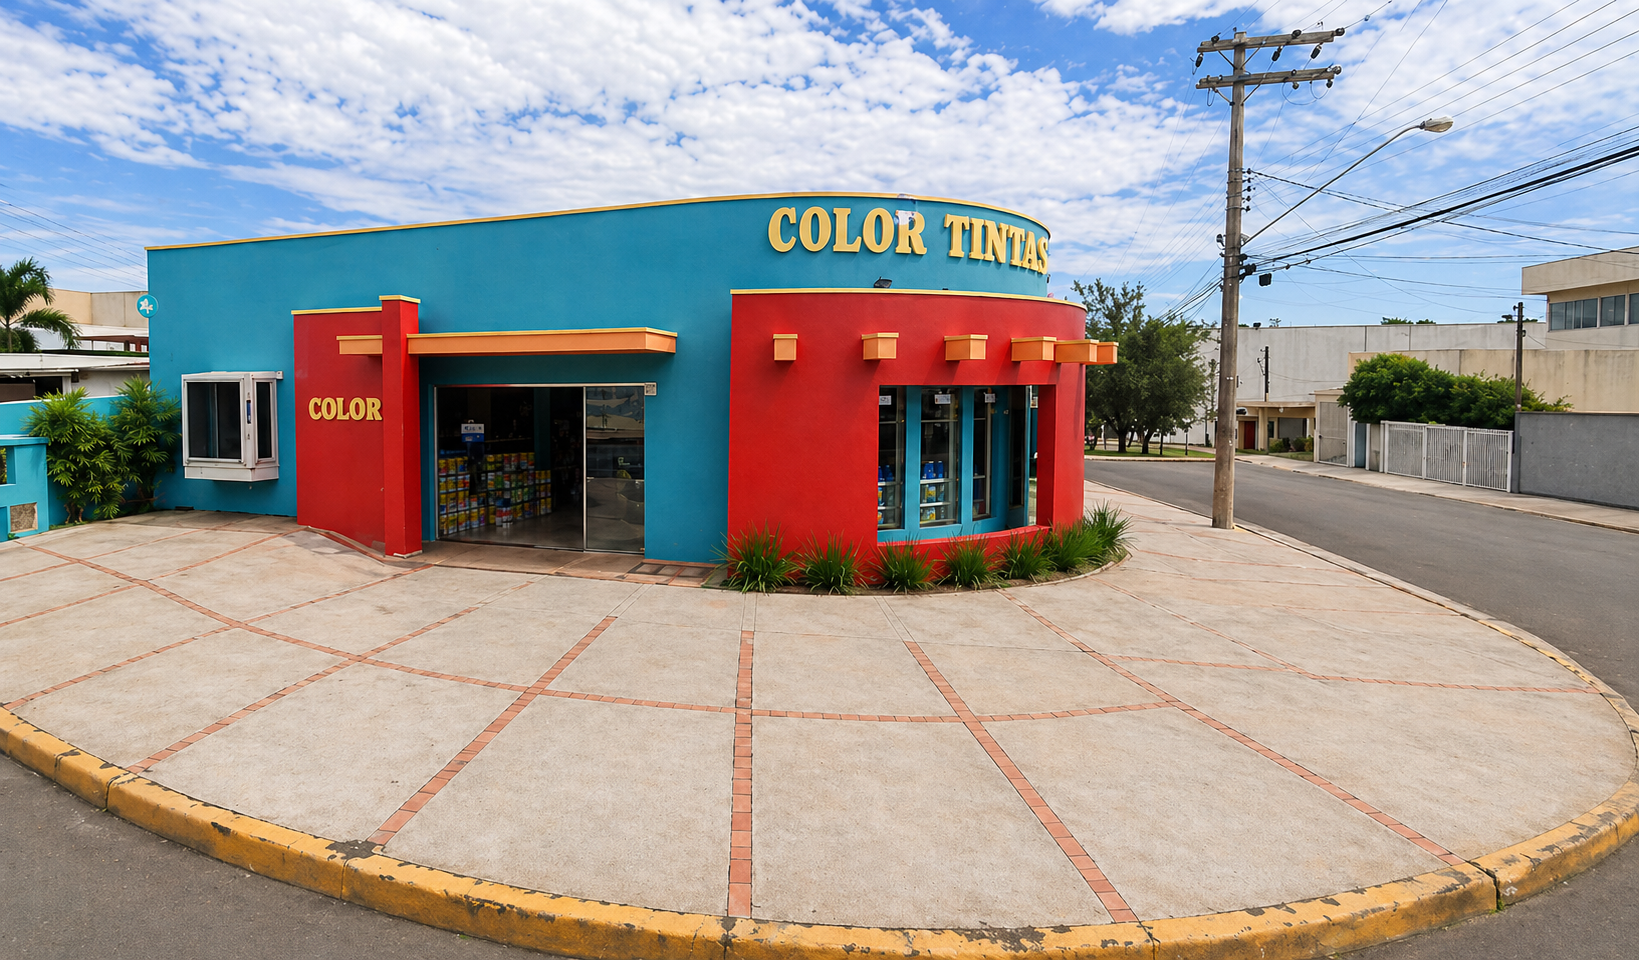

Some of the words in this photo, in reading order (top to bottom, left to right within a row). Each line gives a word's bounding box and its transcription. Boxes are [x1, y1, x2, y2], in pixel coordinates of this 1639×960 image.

[768, 206, 927, 254] COLOR
[944, 213, 1048, 275] TINTAS
[309, 397, 383, 421] COLOR
